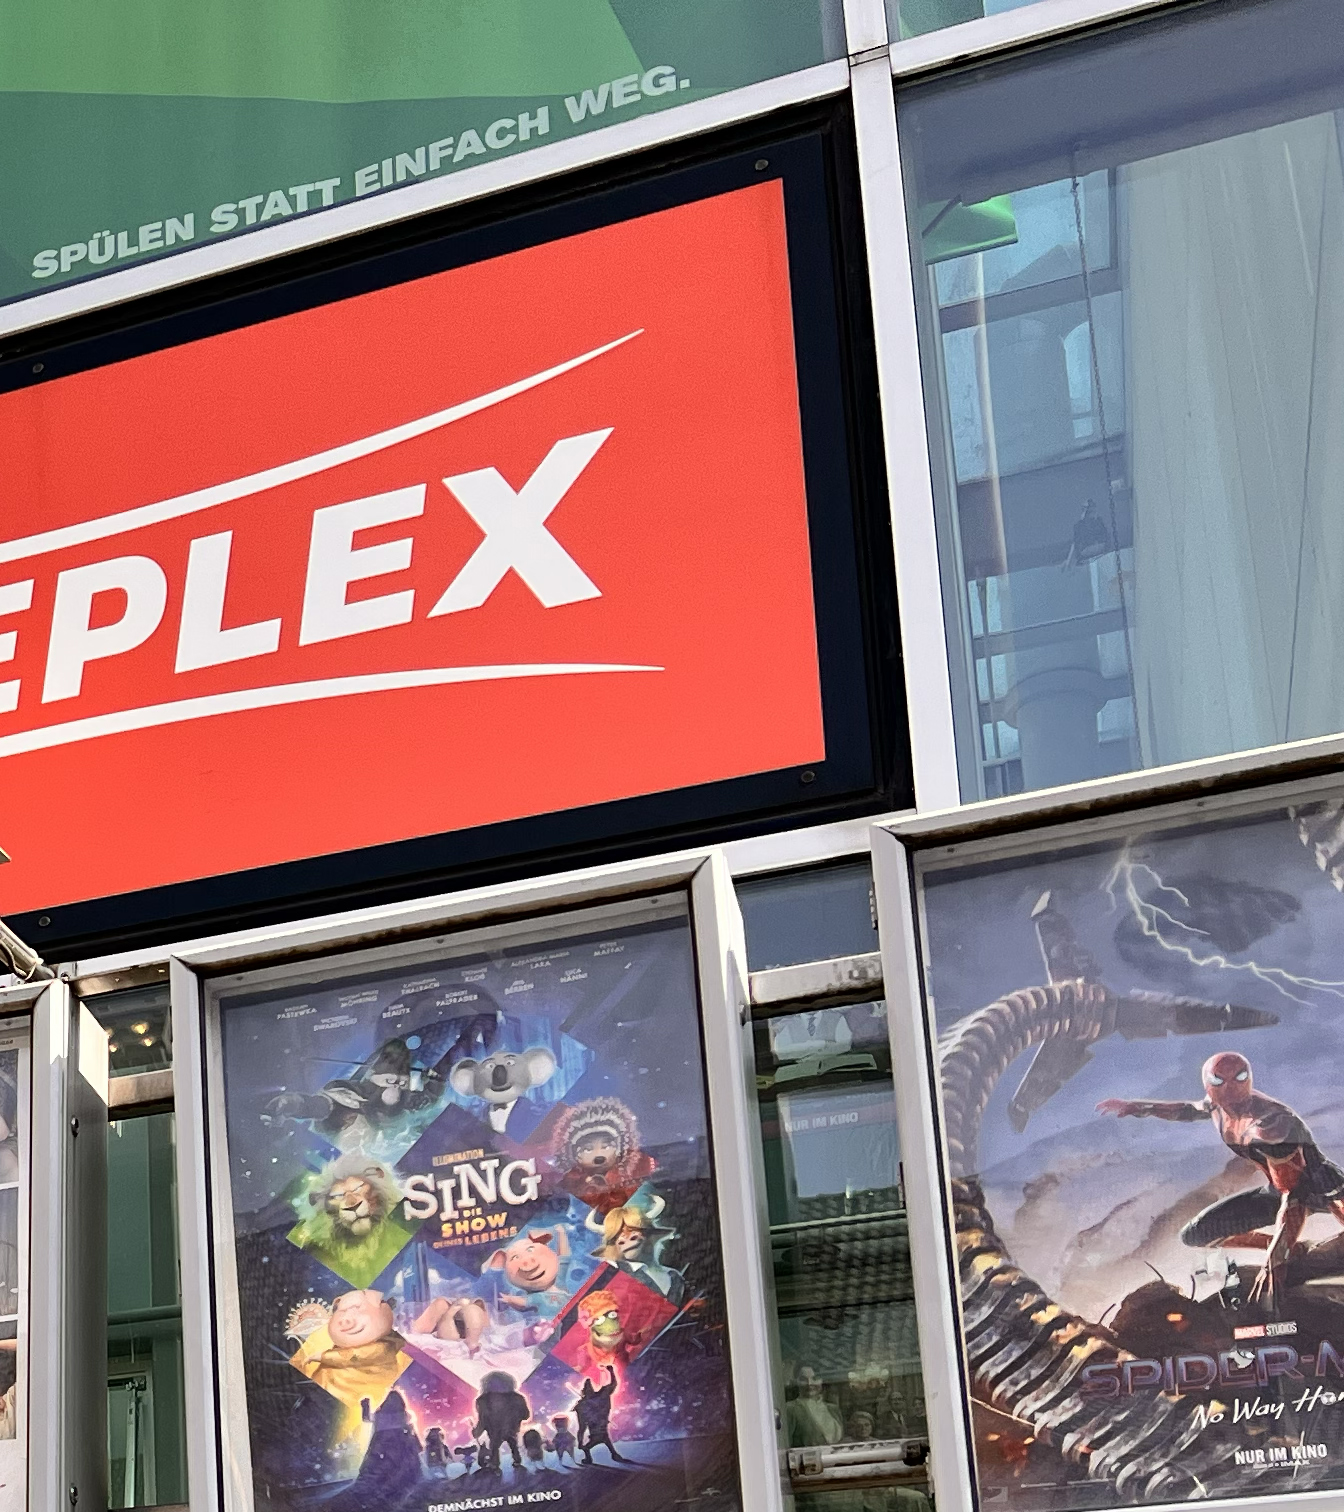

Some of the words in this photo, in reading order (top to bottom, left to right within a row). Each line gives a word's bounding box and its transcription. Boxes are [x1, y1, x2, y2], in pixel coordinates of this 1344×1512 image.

[31, 211, 195, 279] SPÜLEN
[209, 176, 341, 236] STATT
[355, 105, 550, 198] EINFACH
[564, 64, 691, 126] WEG.
[404, 1157, 542, 1222] SING
[463, 1207, 482, 1218] DIE
[441, 1212, 507, 1239] SHOW
[1265, 1321, 1298, 1336] STUDIOS
[1191, 1403, 1224, 1430] No
[1232, 1396, 1285, 1425] Way
[1234, 1449, 1264, 1465] NUR
[1269, 1446, 1289, 1461] IM
[1291, 1443, 1328, 1460] KINO
[508, 1493, 524, 1506] IM
[527, 1489, 562, 1503] KINO
